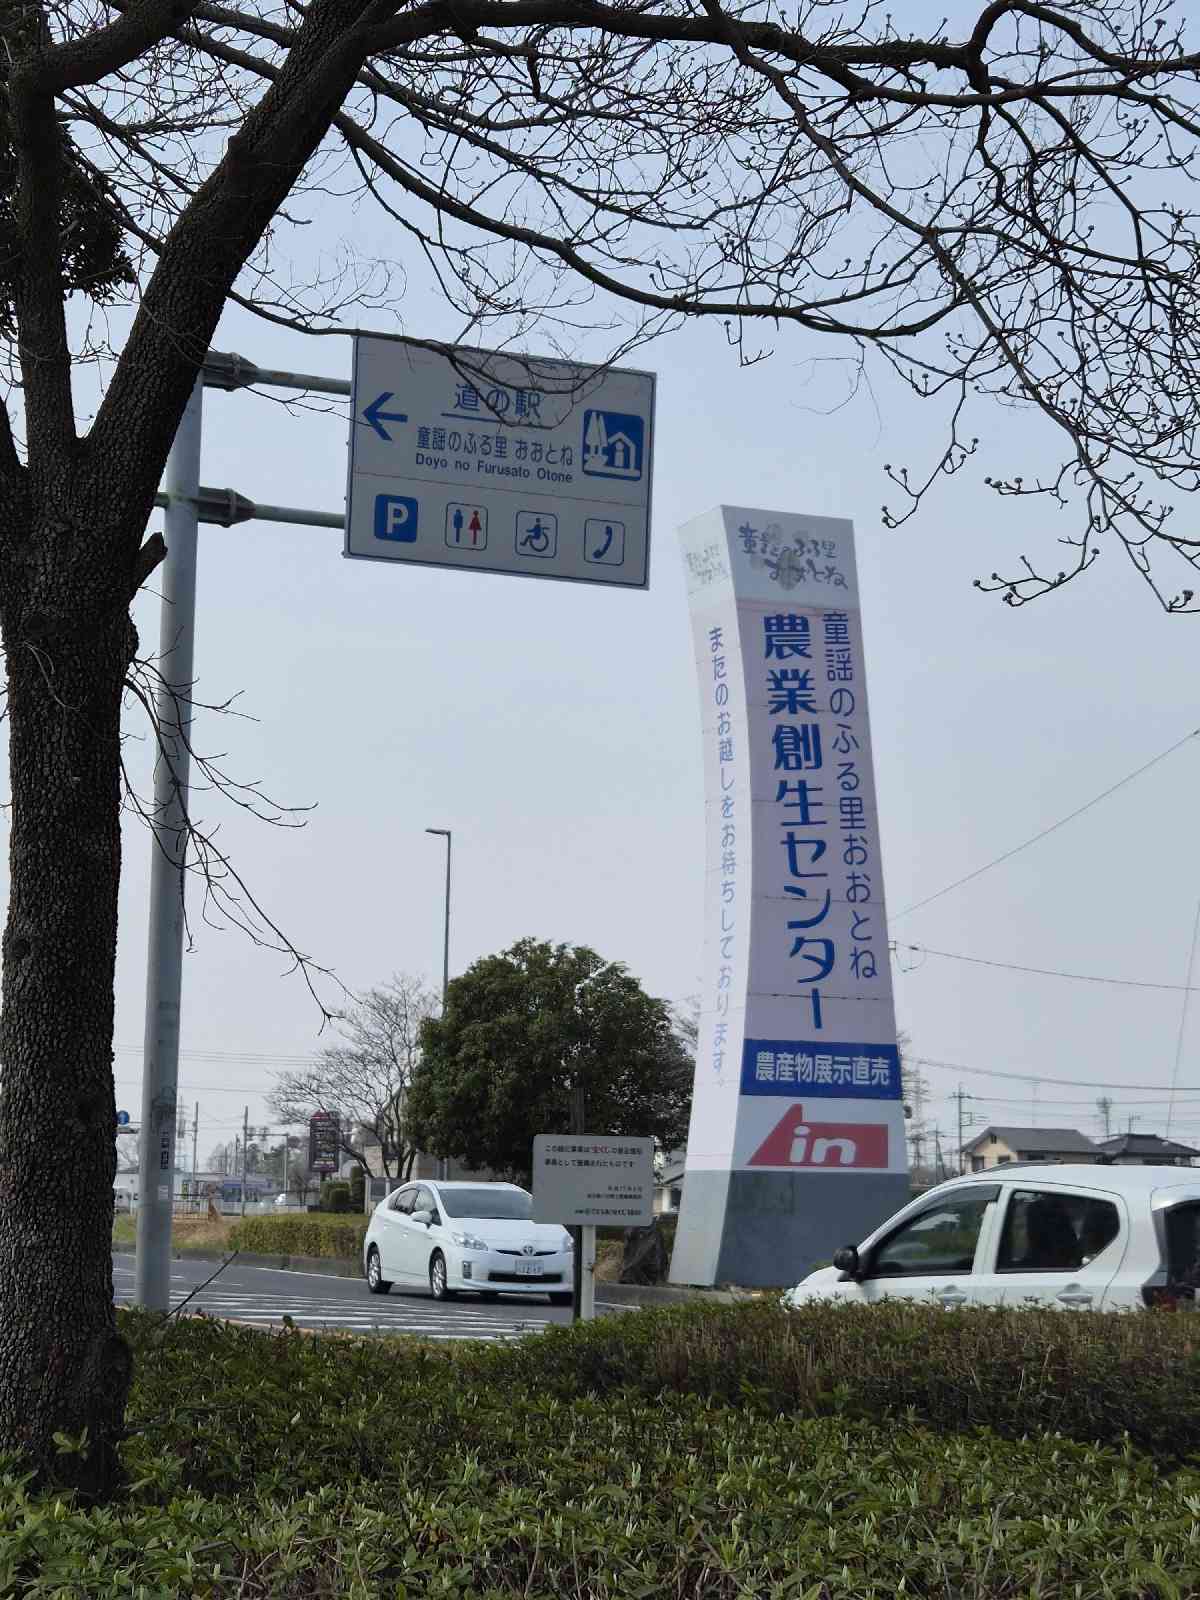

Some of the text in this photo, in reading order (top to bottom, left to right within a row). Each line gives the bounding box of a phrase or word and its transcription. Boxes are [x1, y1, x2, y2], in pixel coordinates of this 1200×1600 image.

[454, 383, 541, 418] 道の駅
[416, 425, 574, 466] 童謡のふる里 おおとね
[415, 452, 573, 484] Doyo no Furusato Otone
[386, 502, 409, 534] P
[821, 610, 878, 980] 童謡のふる里おおとね
[762, 613, 836, 1029] 農業創生センター
[755, 1050, 890, 1086] 農産物展示直売
